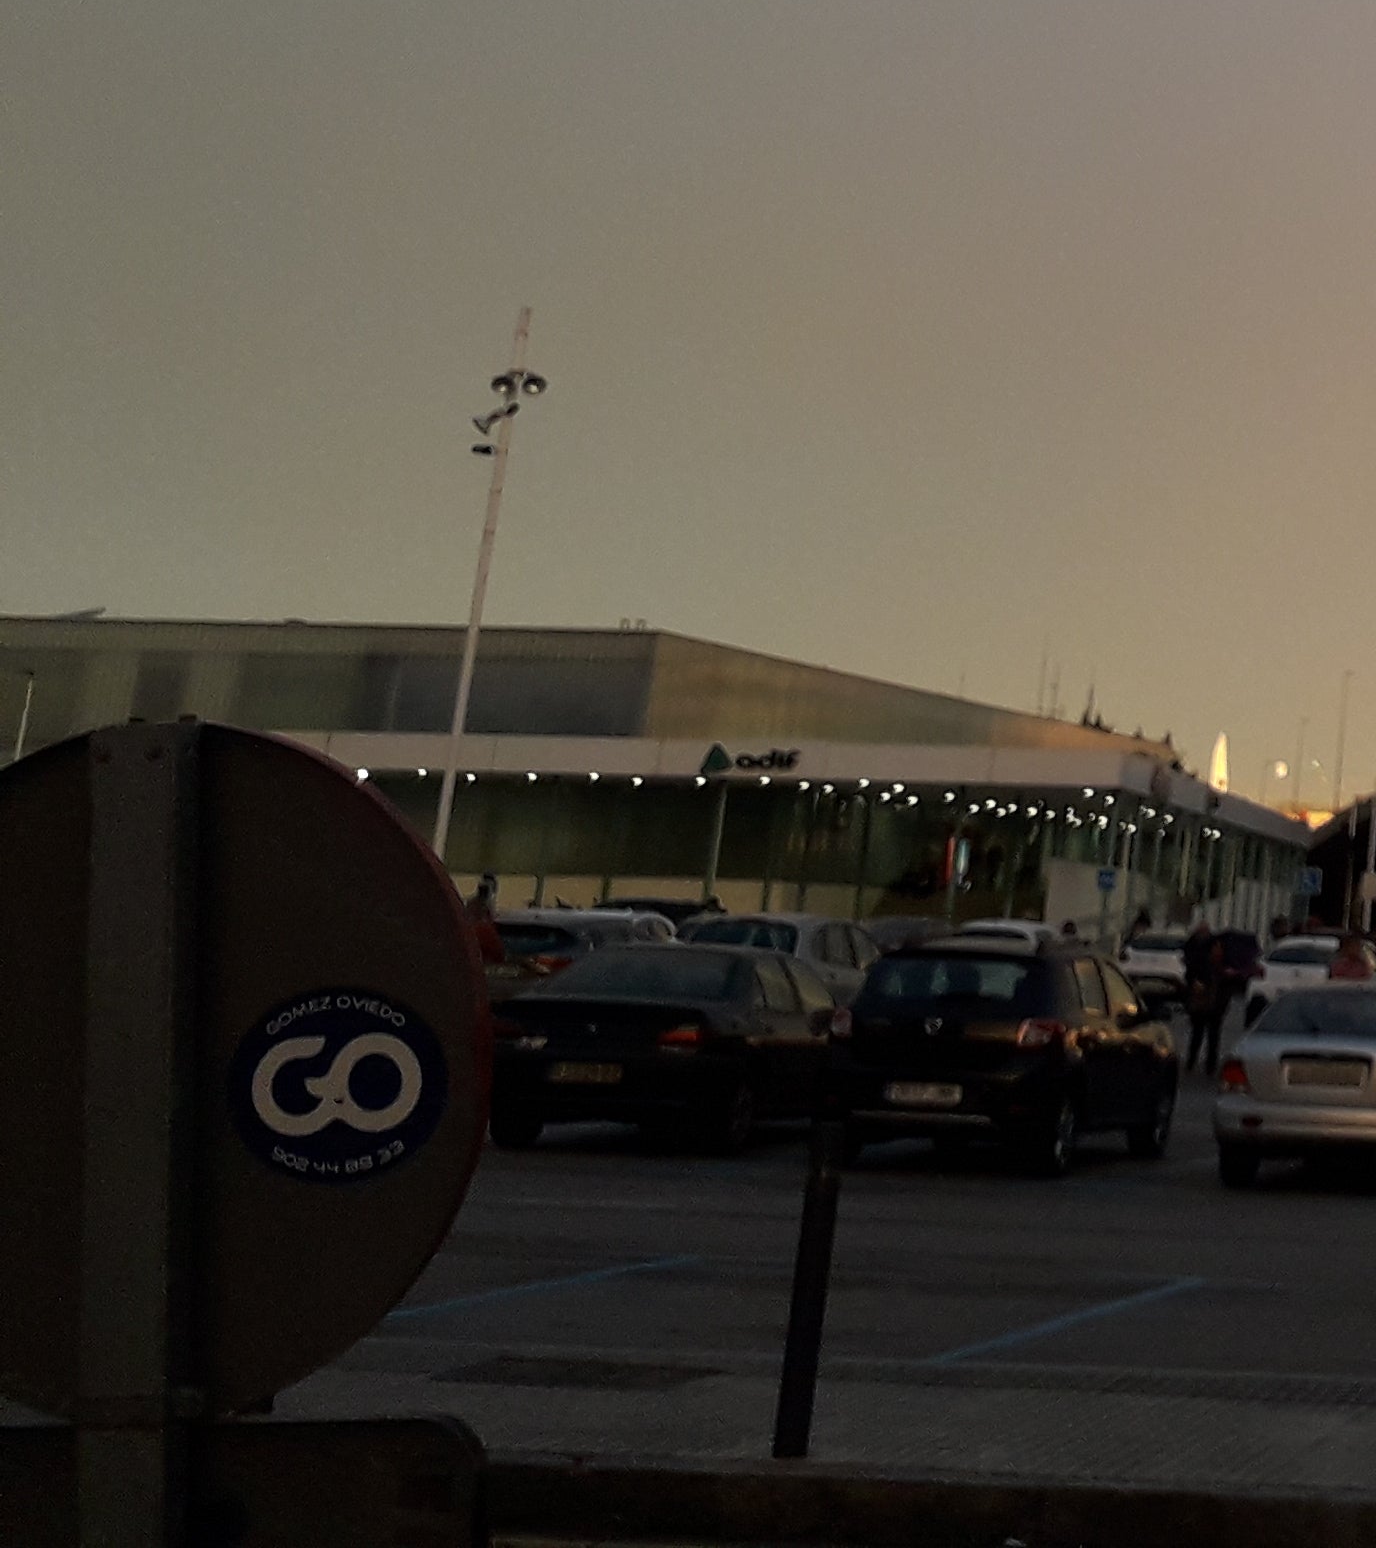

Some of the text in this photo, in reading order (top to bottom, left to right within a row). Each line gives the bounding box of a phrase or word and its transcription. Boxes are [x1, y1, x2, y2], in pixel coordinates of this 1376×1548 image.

[266, 995, 406, 1035] GOMEZ OVIEDO
[251, 1031, 423, 1138] GO
